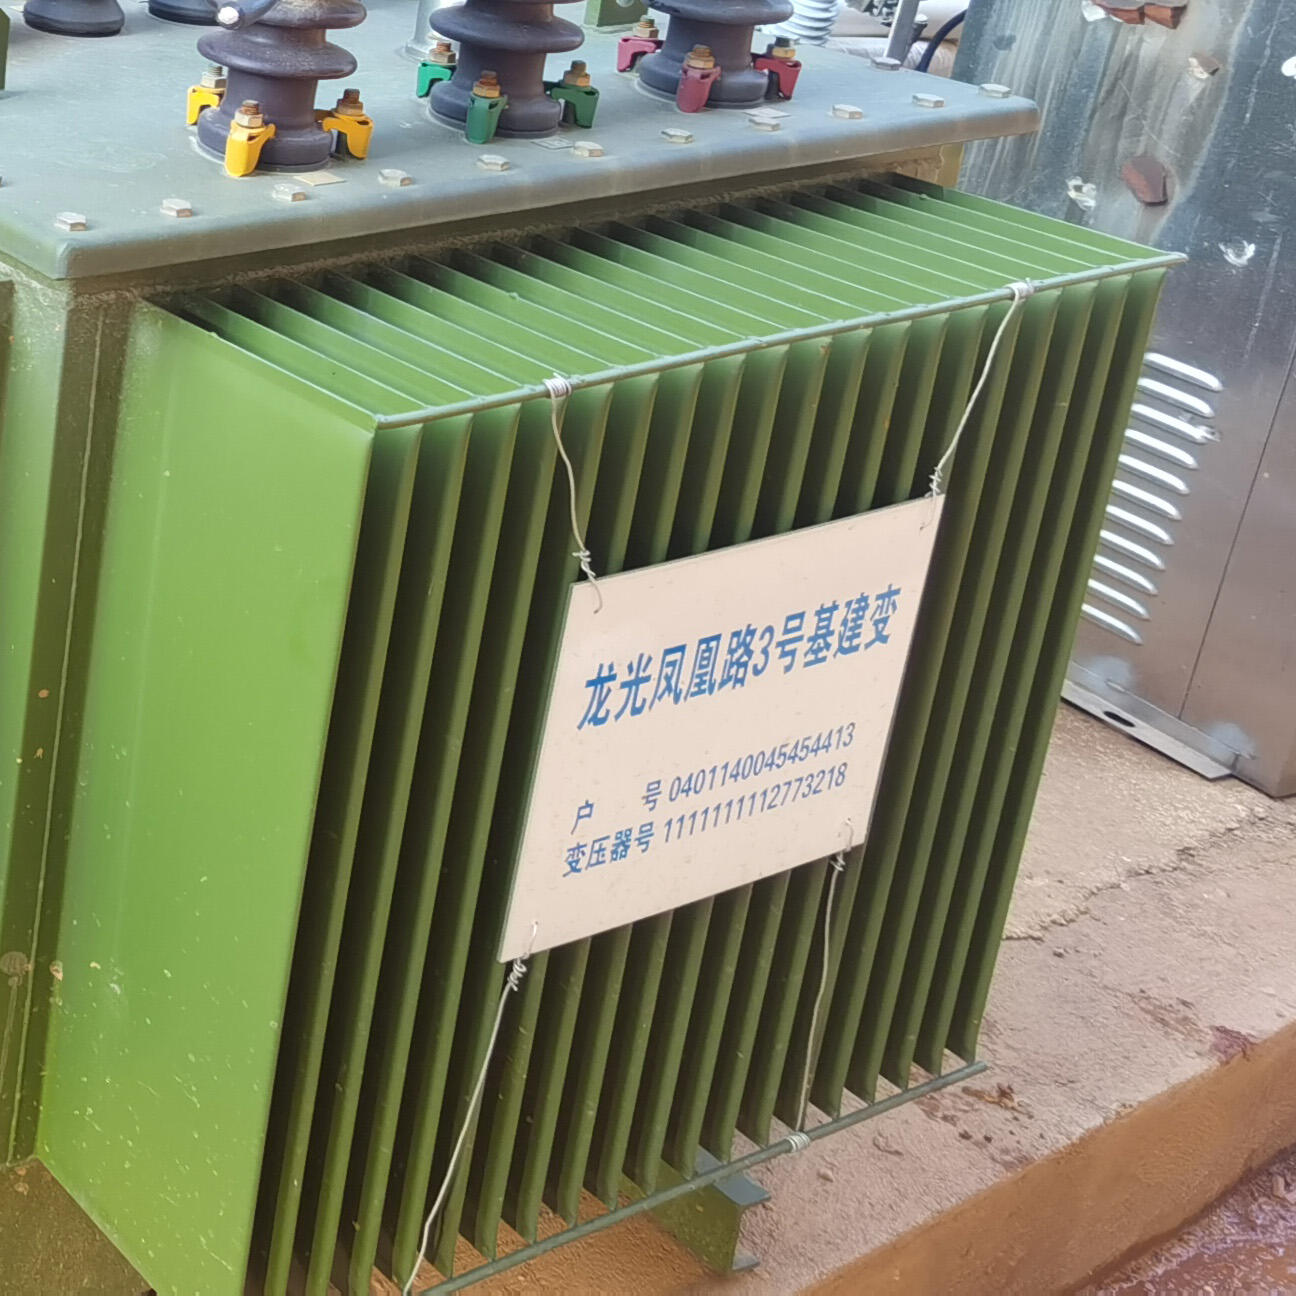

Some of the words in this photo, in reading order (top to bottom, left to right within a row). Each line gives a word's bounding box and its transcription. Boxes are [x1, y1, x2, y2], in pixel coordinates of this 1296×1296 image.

[577, 584, 902, 731] 龙光凤凰路3号基建变
[562, 822, 655, 878] 变压器号
[663, 762, 849, 843] 1111111112773218
[570, 779, 662, 835] 户号
[668, 722, 856, 803] 0401140045454413
